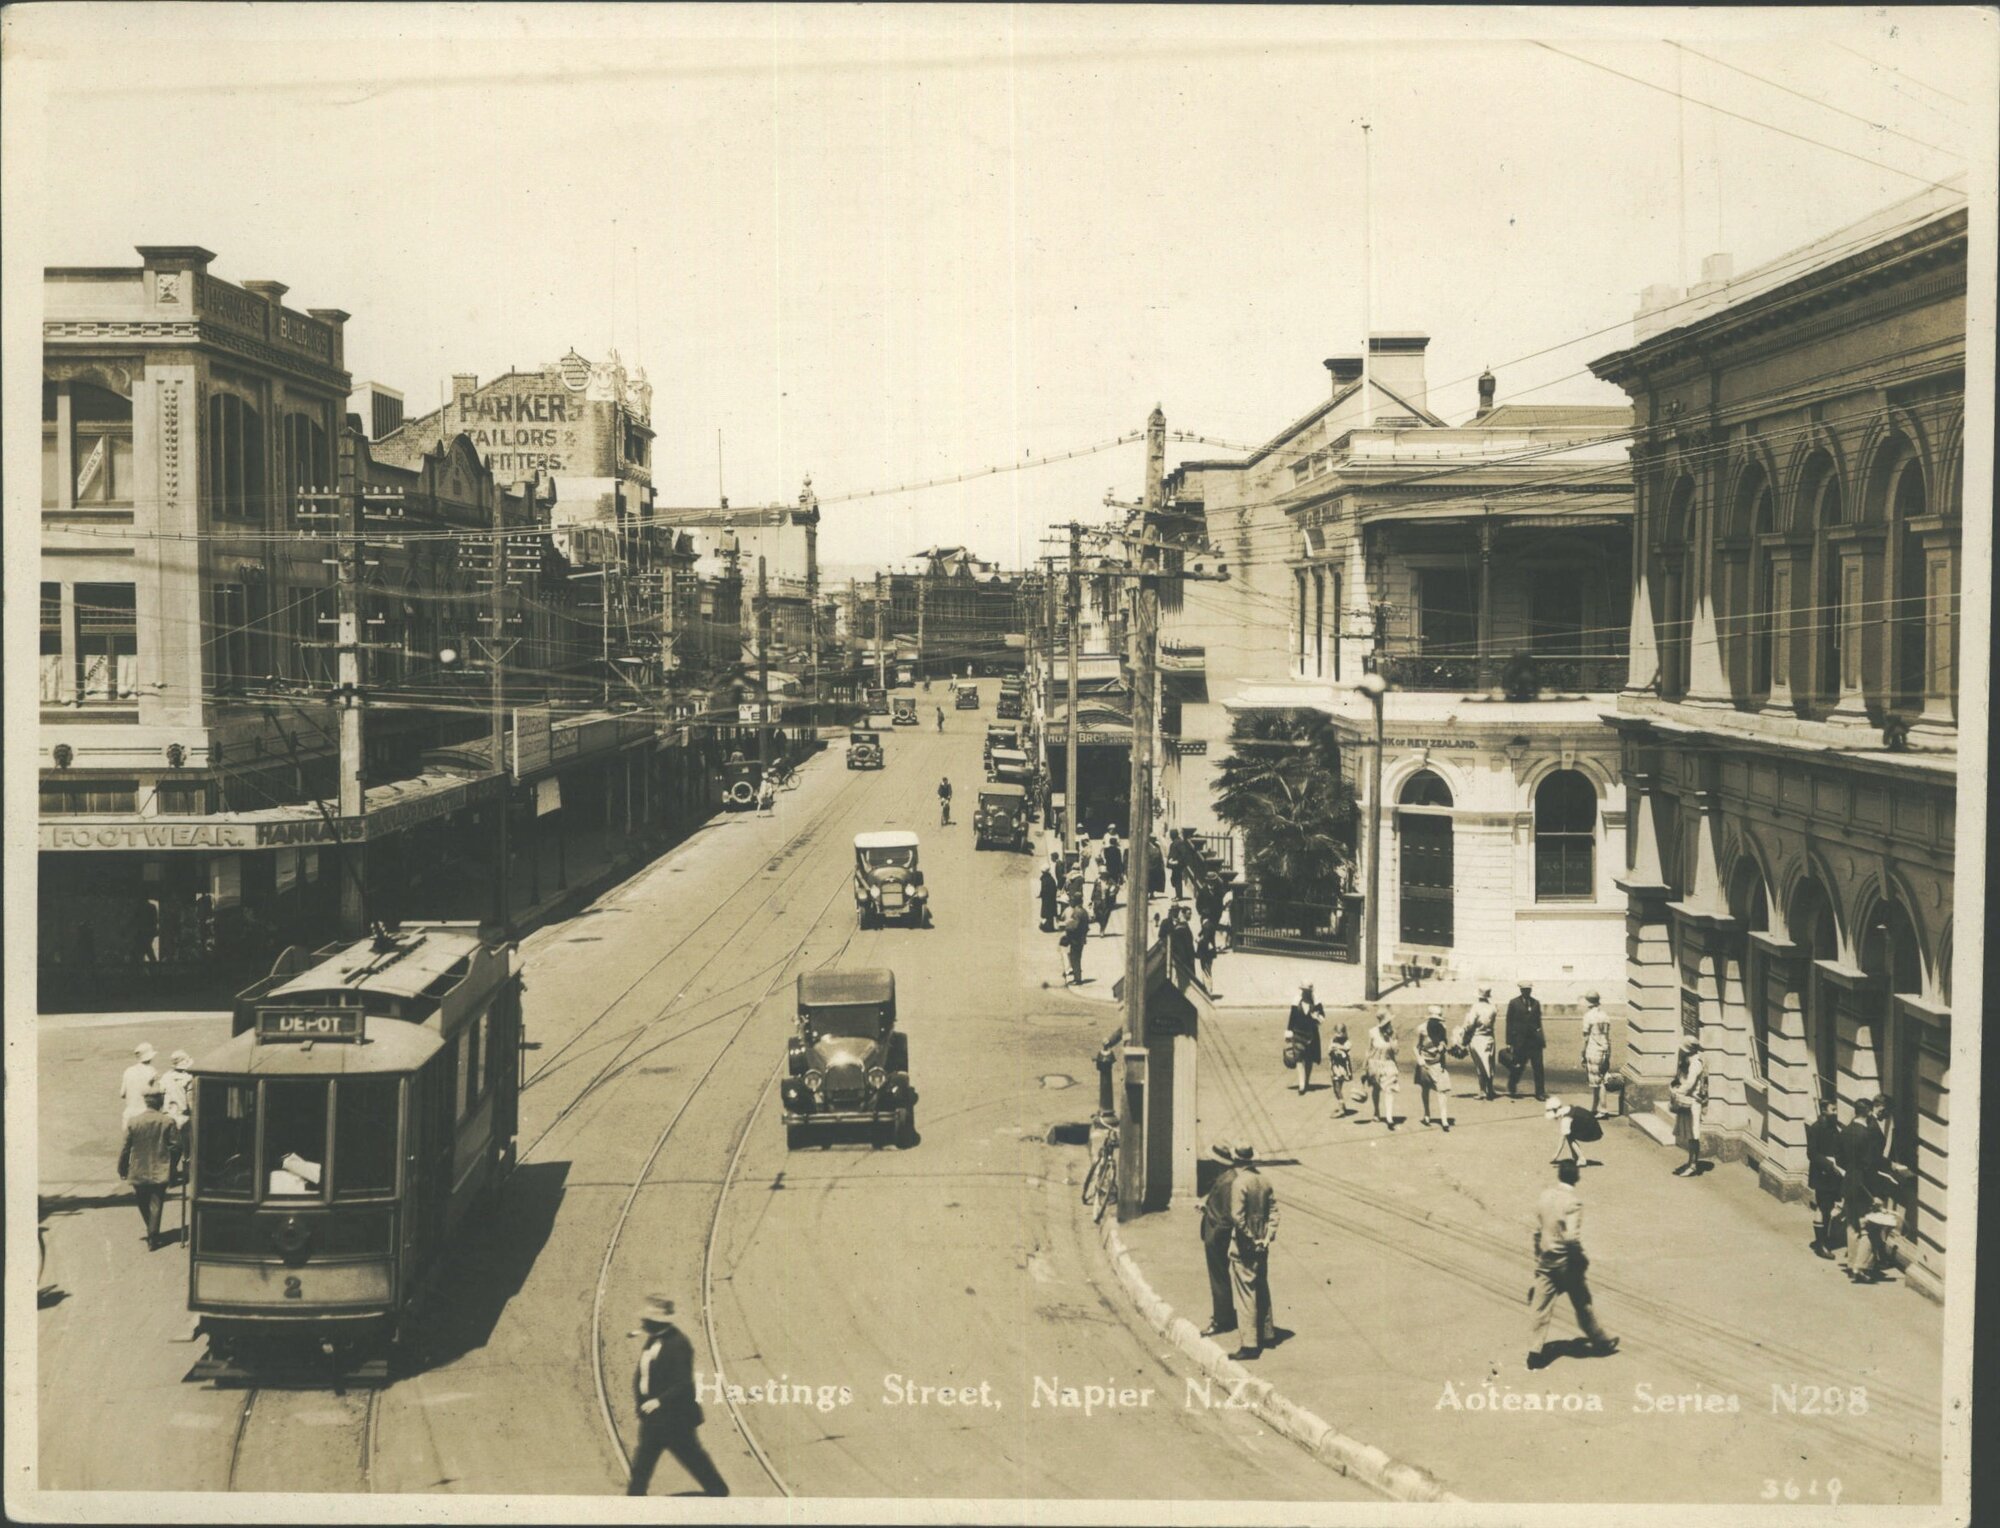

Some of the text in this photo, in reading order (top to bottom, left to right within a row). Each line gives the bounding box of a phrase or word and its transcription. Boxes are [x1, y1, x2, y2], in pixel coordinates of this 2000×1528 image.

[281, 316, 327, 353] BUILDINGS
[463, 429, 558, 447] TAILORS
[1407, 739, 1428, 748] NEW
[53, 826, 245, 848] FOOTWEAR.
[280, 1015, 342, 1033] DEPOT
[284, 1276, 302, 1299] 2
